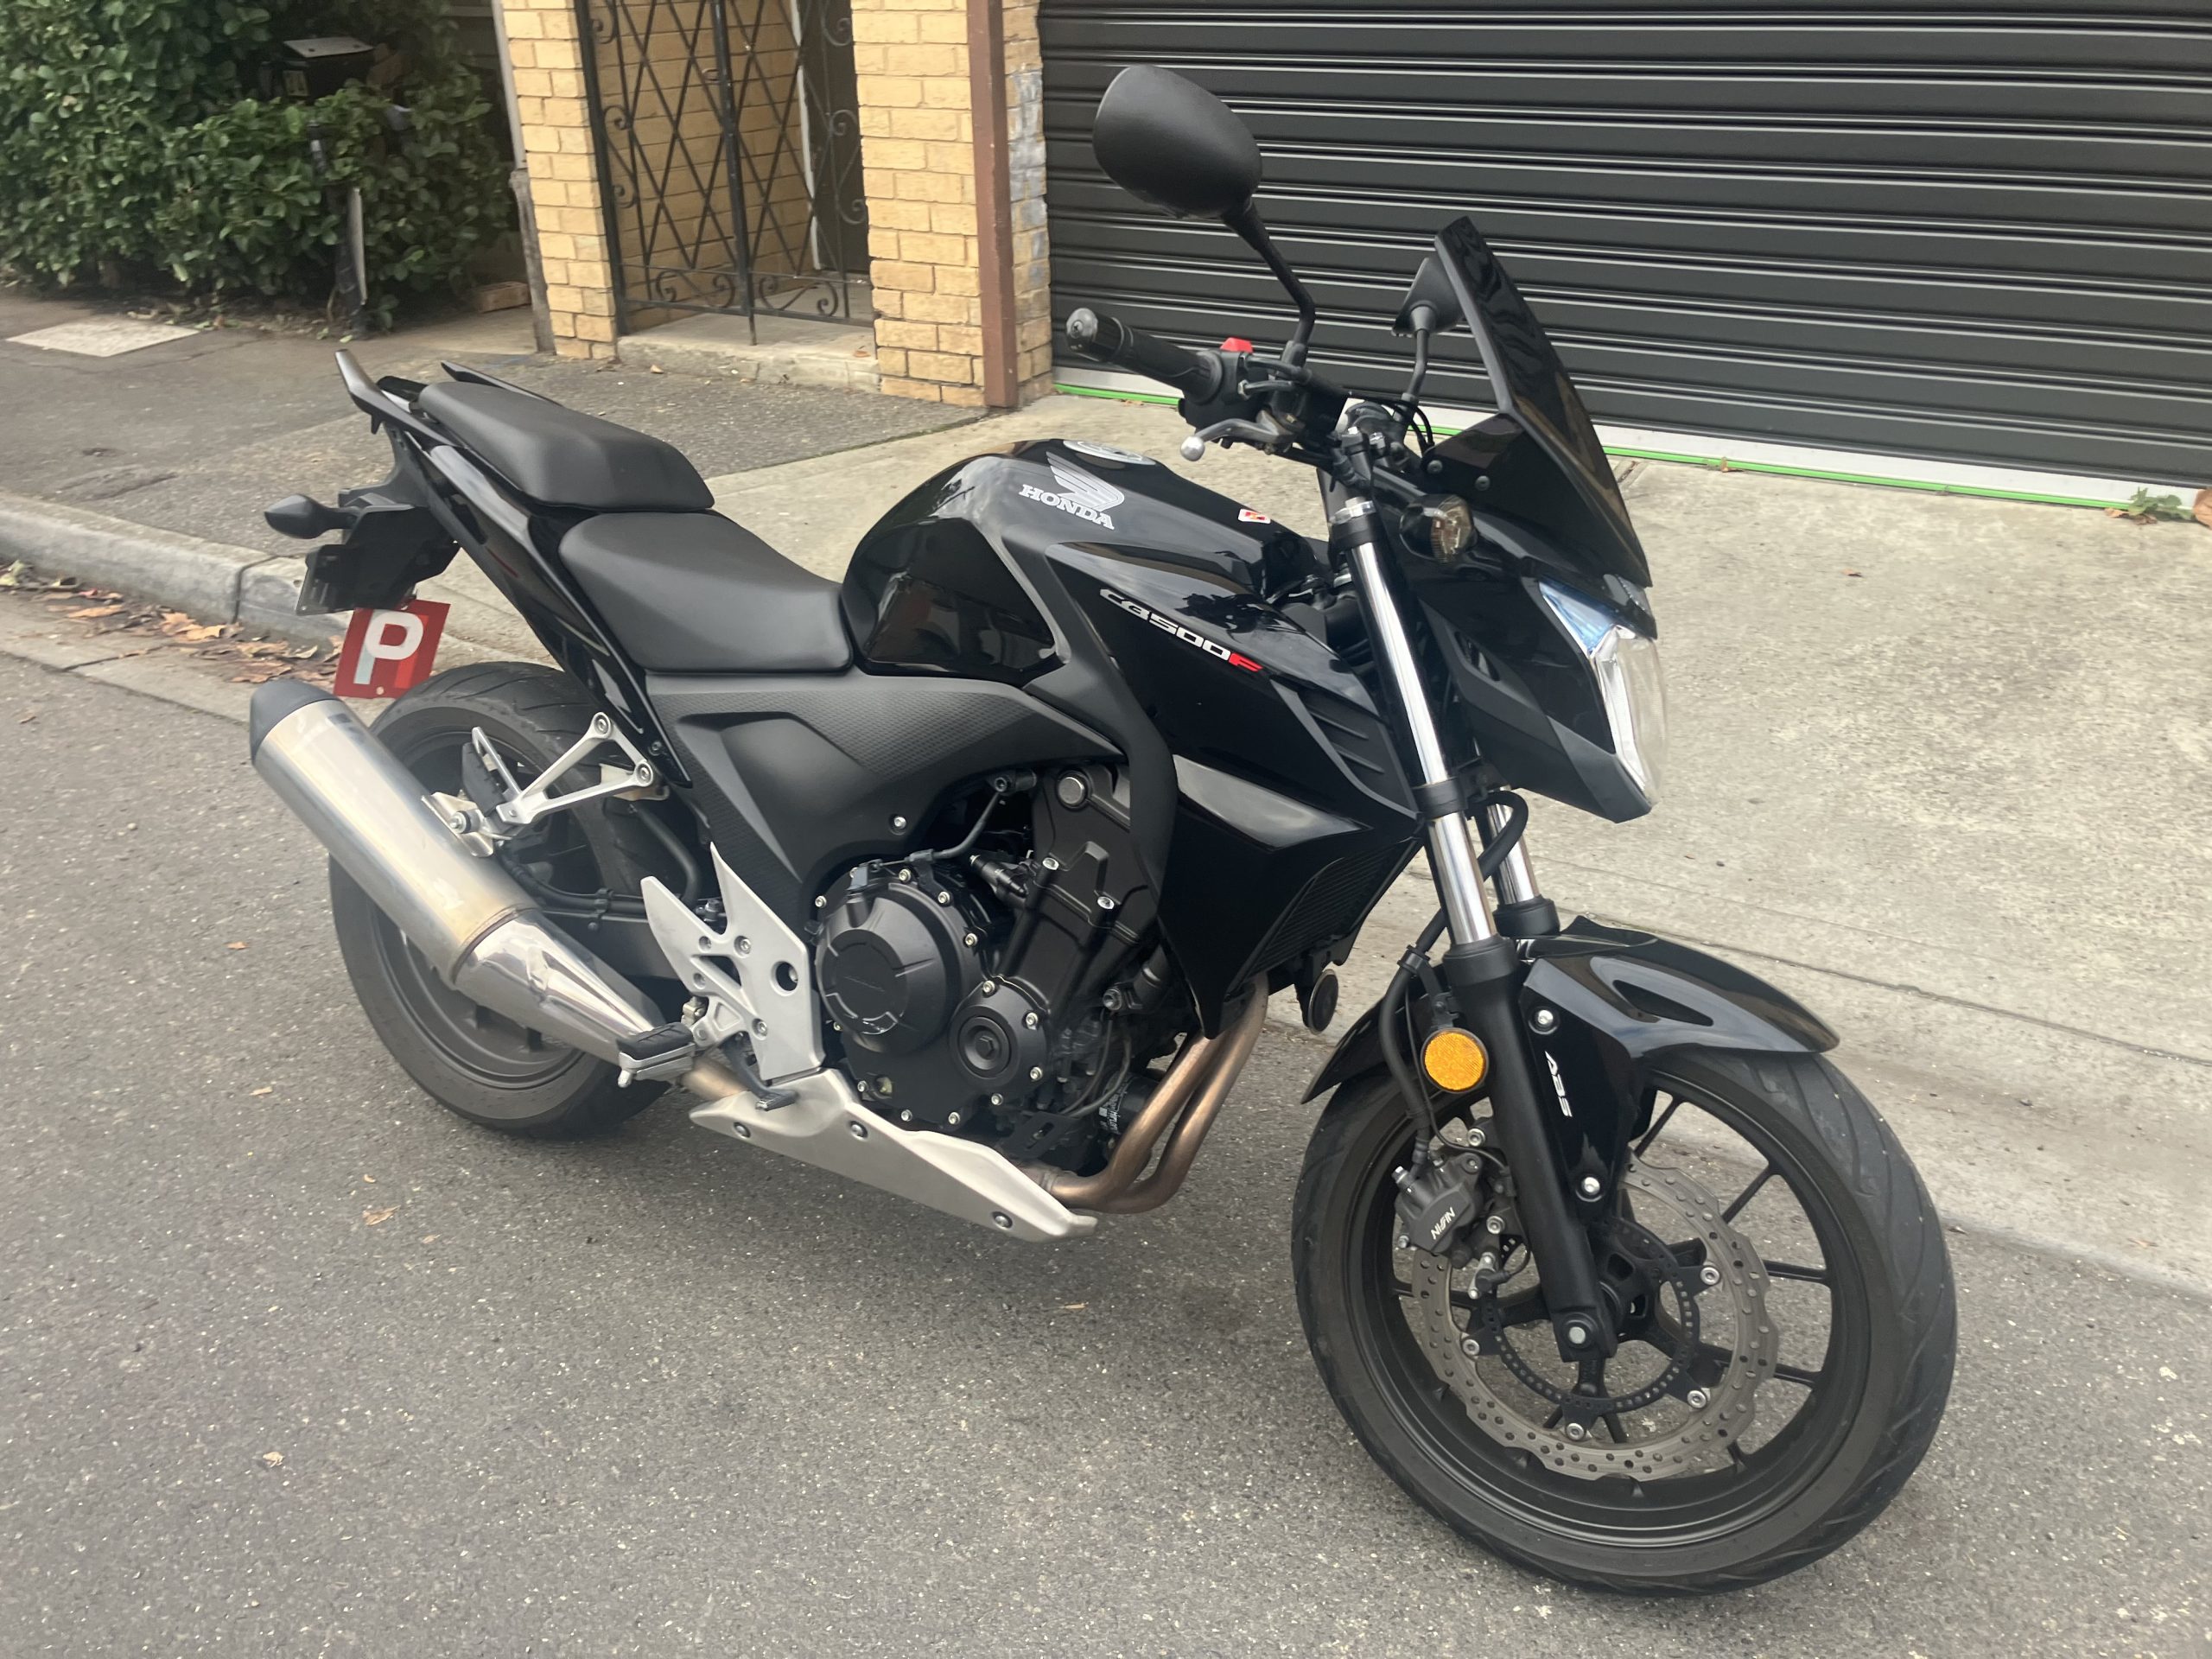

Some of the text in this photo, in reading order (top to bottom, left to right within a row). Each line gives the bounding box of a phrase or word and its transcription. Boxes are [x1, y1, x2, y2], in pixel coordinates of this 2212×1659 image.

[1019, 484, 1115, 530] HONDA
[353, 608, 424, 685] P
[1100, 588, 1263, 672] CB500F
[1544, 1051, 1573, 1117] ABS
